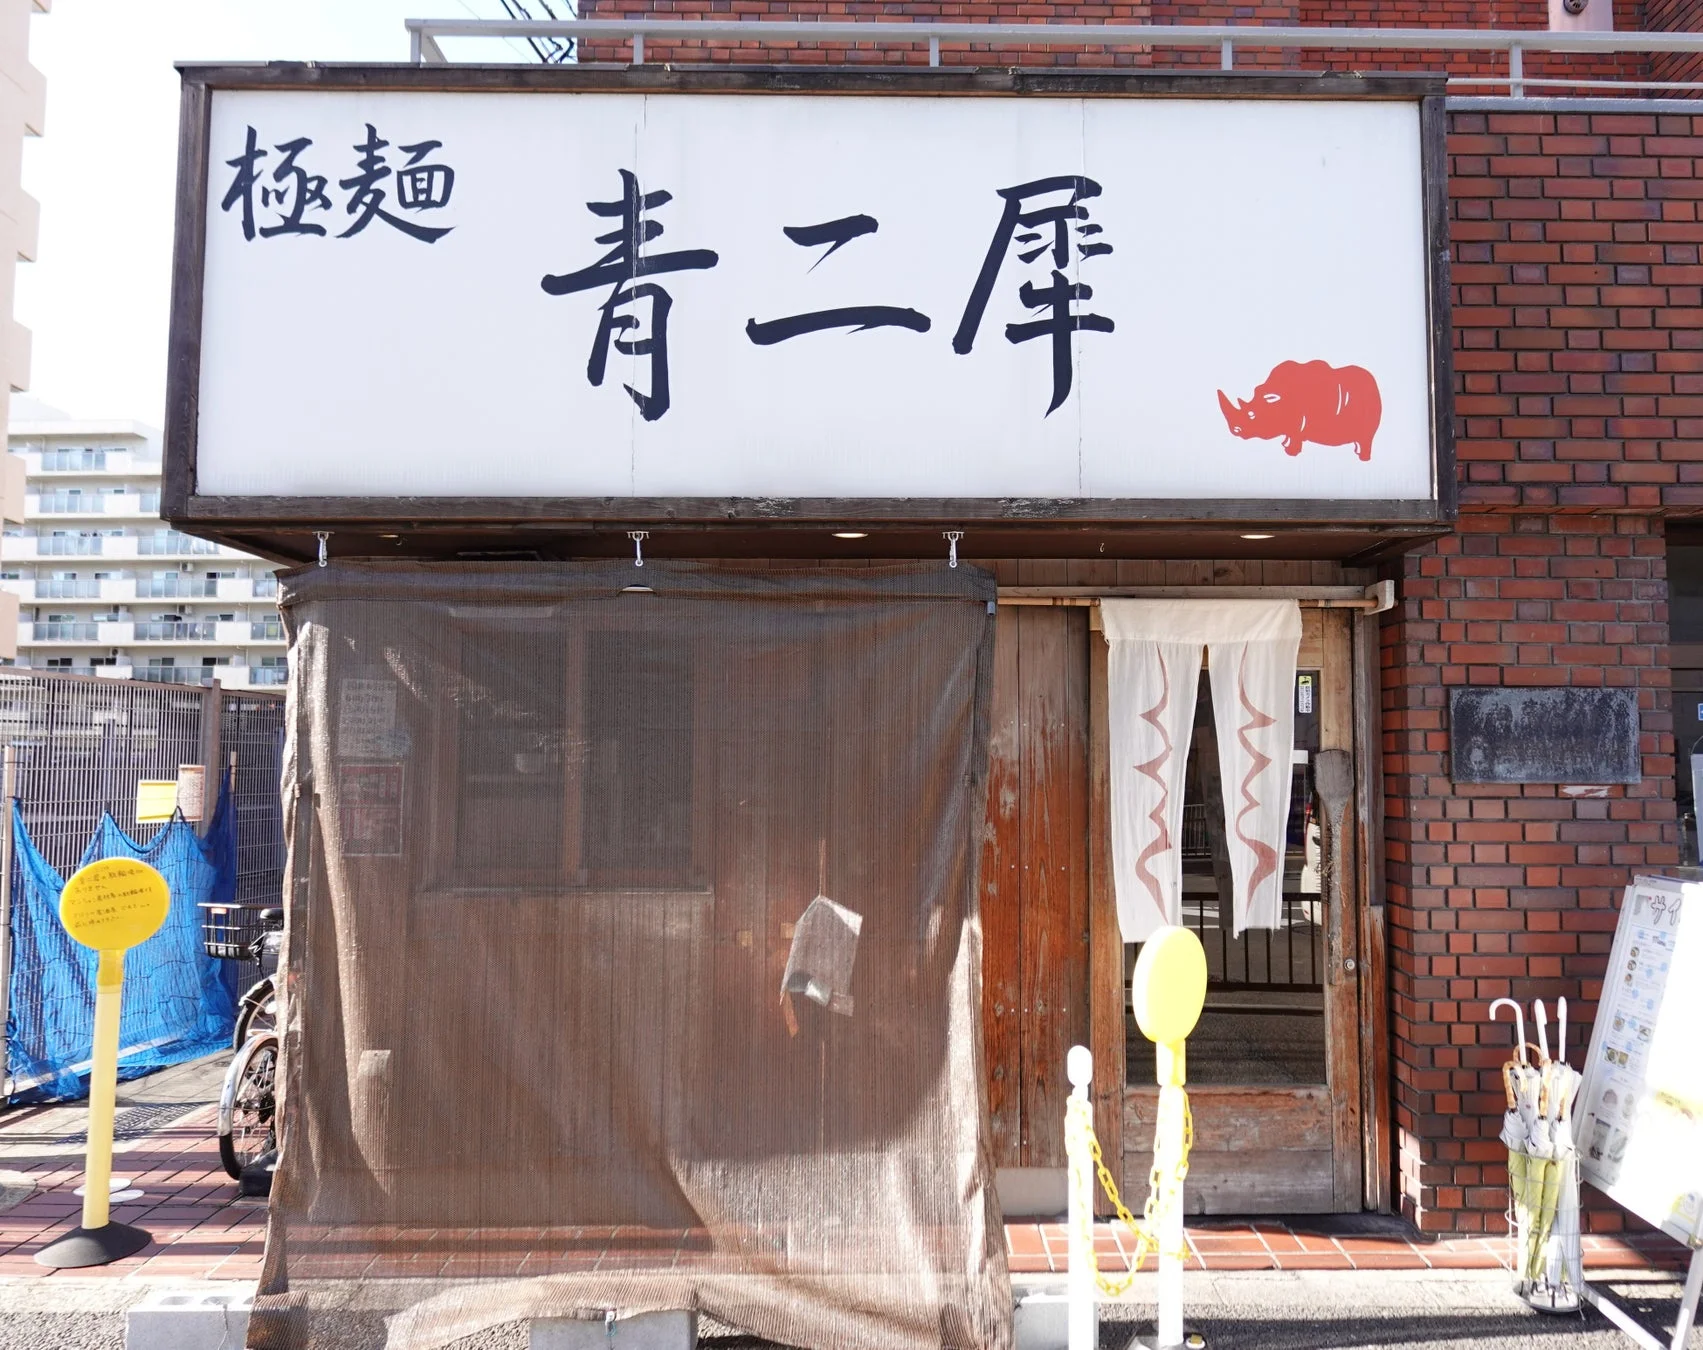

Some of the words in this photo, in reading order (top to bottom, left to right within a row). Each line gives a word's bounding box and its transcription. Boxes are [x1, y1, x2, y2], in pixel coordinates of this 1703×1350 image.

[221, 123, 457, 244] 極麺
[541, 168, 1115, 421] 青二犀
